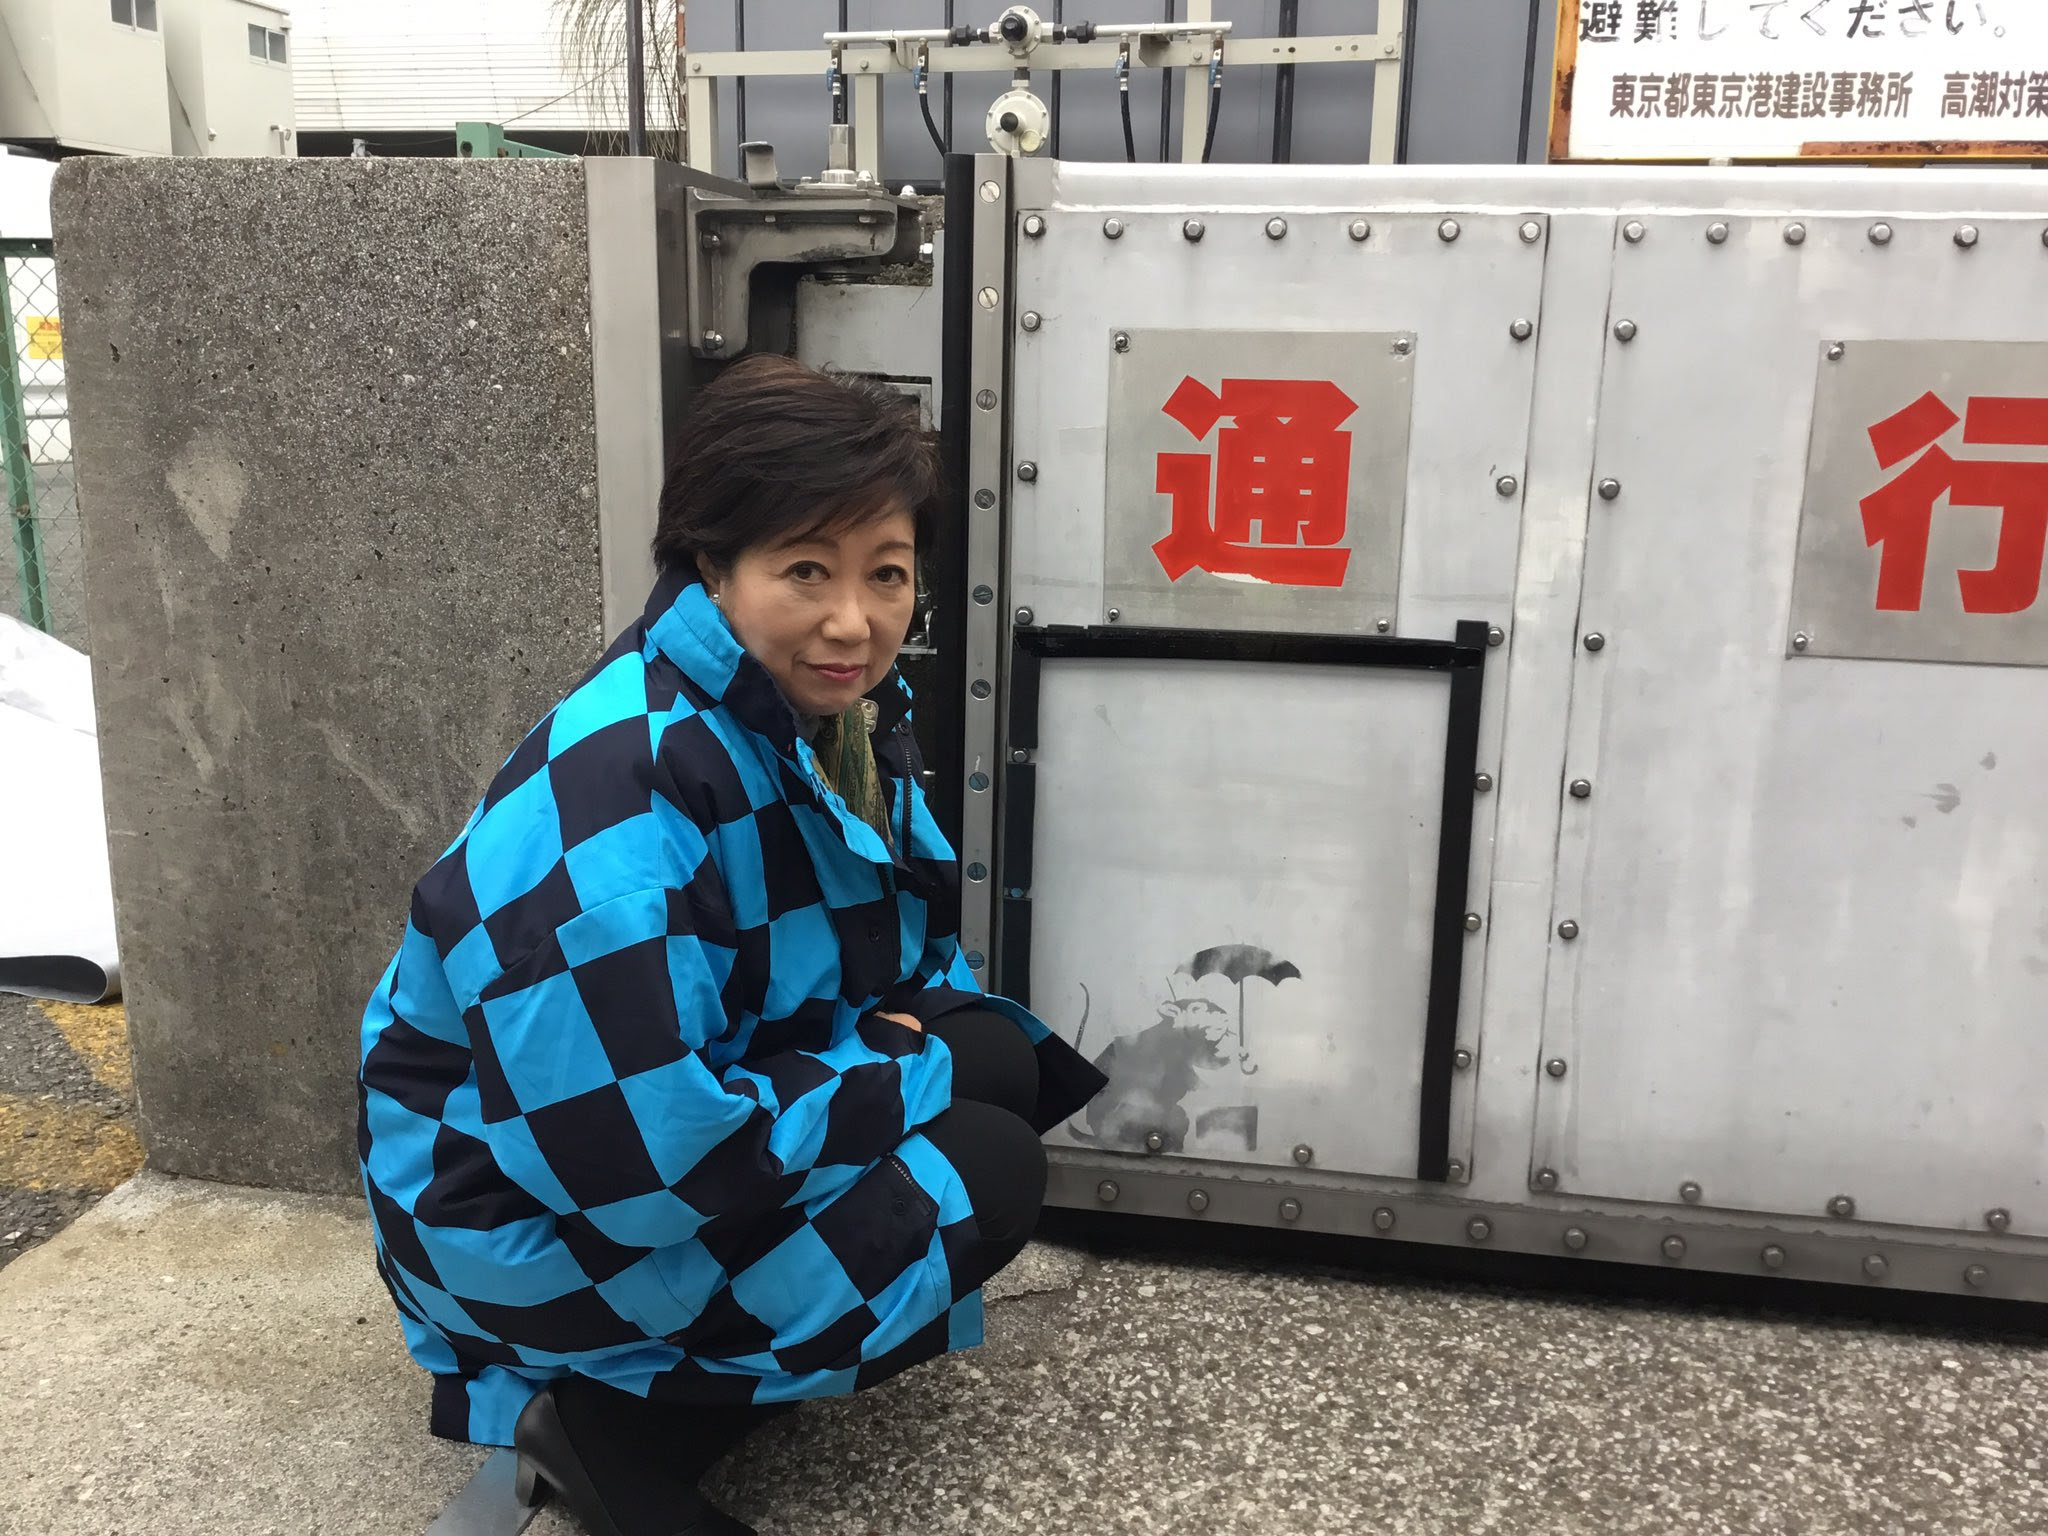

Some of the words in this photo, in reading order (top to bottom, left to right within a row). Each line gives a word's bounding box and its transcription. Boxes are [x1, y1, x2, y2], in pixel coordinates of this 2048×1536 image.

[1610, 71, 1913, 118] 東京都東京港建設事務所
[1153, 377, 1357, 587] 通
[1860, 392, 2048, 613] 行
